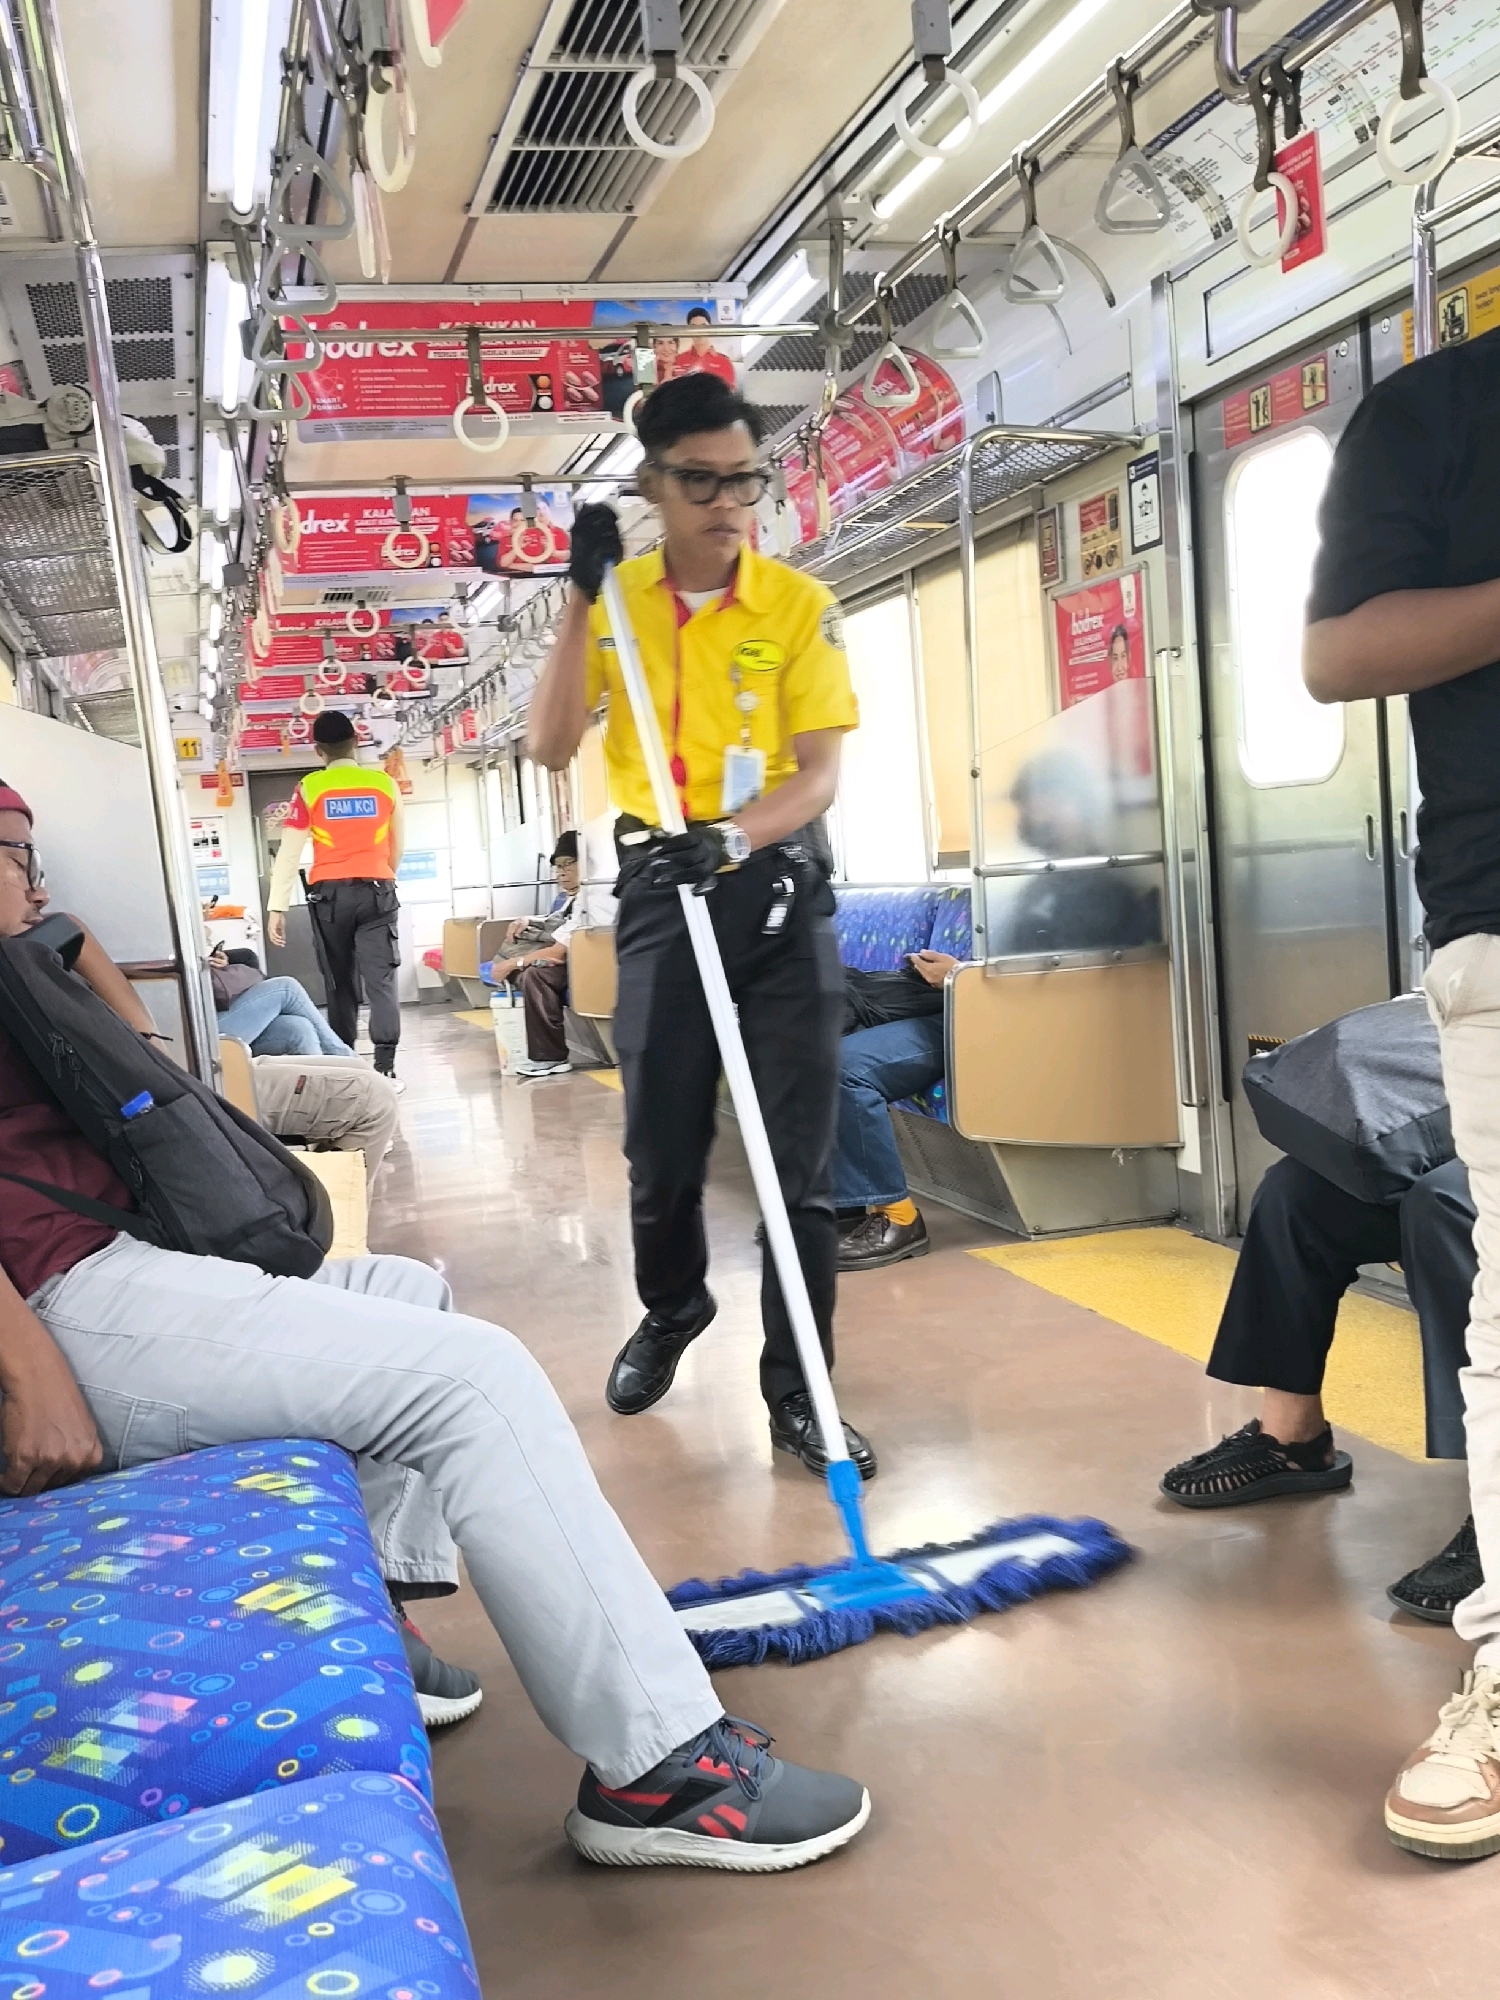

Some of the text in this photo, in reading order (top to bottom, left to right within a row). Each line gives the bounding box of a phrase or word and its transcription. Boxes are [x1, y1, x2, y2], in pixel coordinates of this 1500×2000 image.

[466, 376, 517, 394] bdrex
[182, 740, 198, 757] 11
[329, 799, 375, 815] PAM KCI
